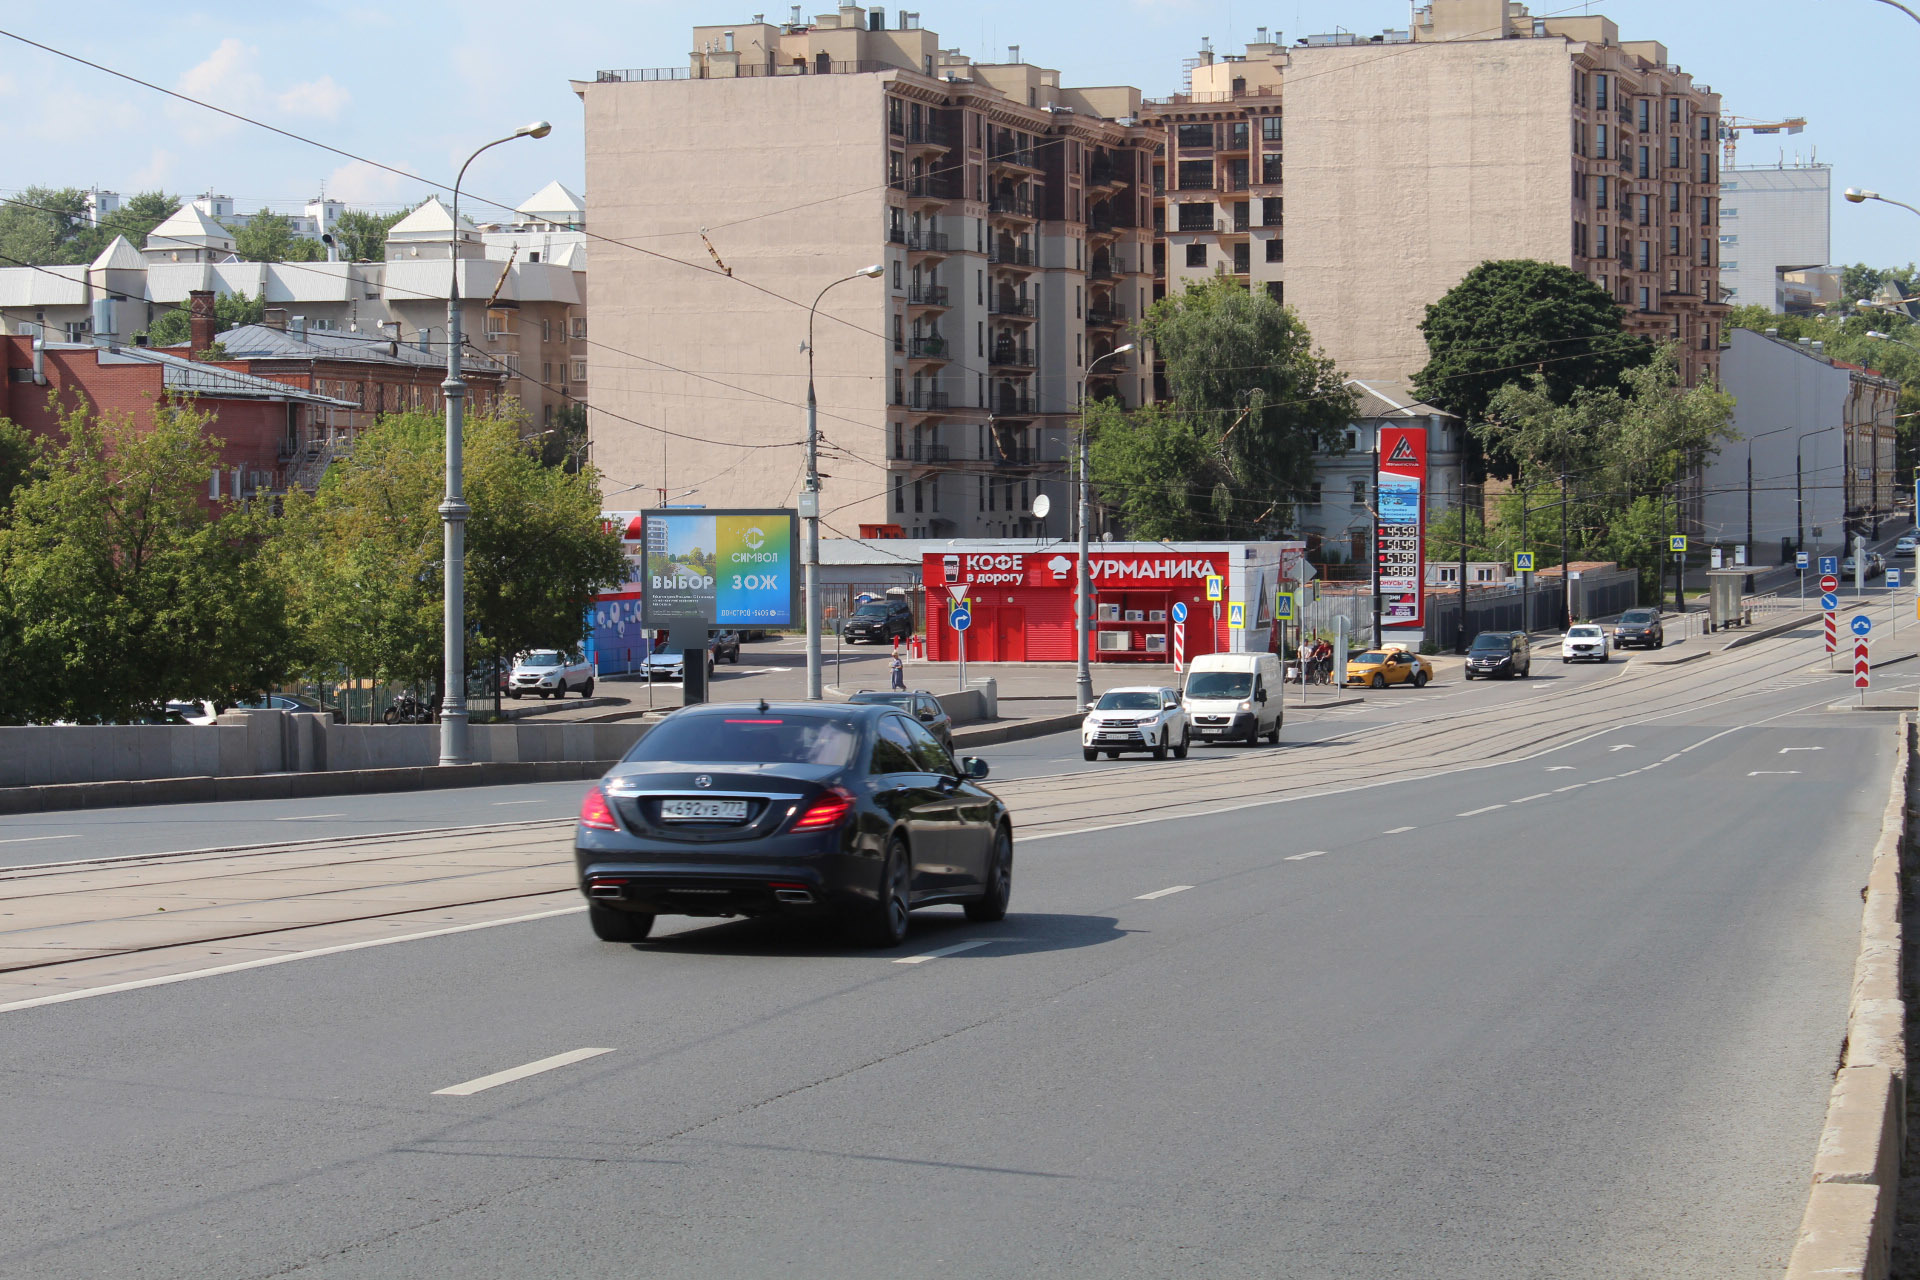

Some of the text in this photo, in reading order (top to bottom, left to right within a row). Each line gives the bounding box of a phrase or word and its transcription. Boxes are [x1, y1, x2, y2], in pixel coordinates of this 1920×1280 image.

[1387, 527, 1415, 537] 45.59
[1387, 540, 1415, 550] 50.49
[731, 552, 778, 563] СИМВОЛ
[966, 554, 1023, 571] КОФЕ
[1387, 553, 1414, 564] 57.99
[1387, 566, 1414, 577] 49.89
[652, 574, 778, 590] ВЫБОР ЗОЖ
[977, 573, 1023, 585] дорогу
